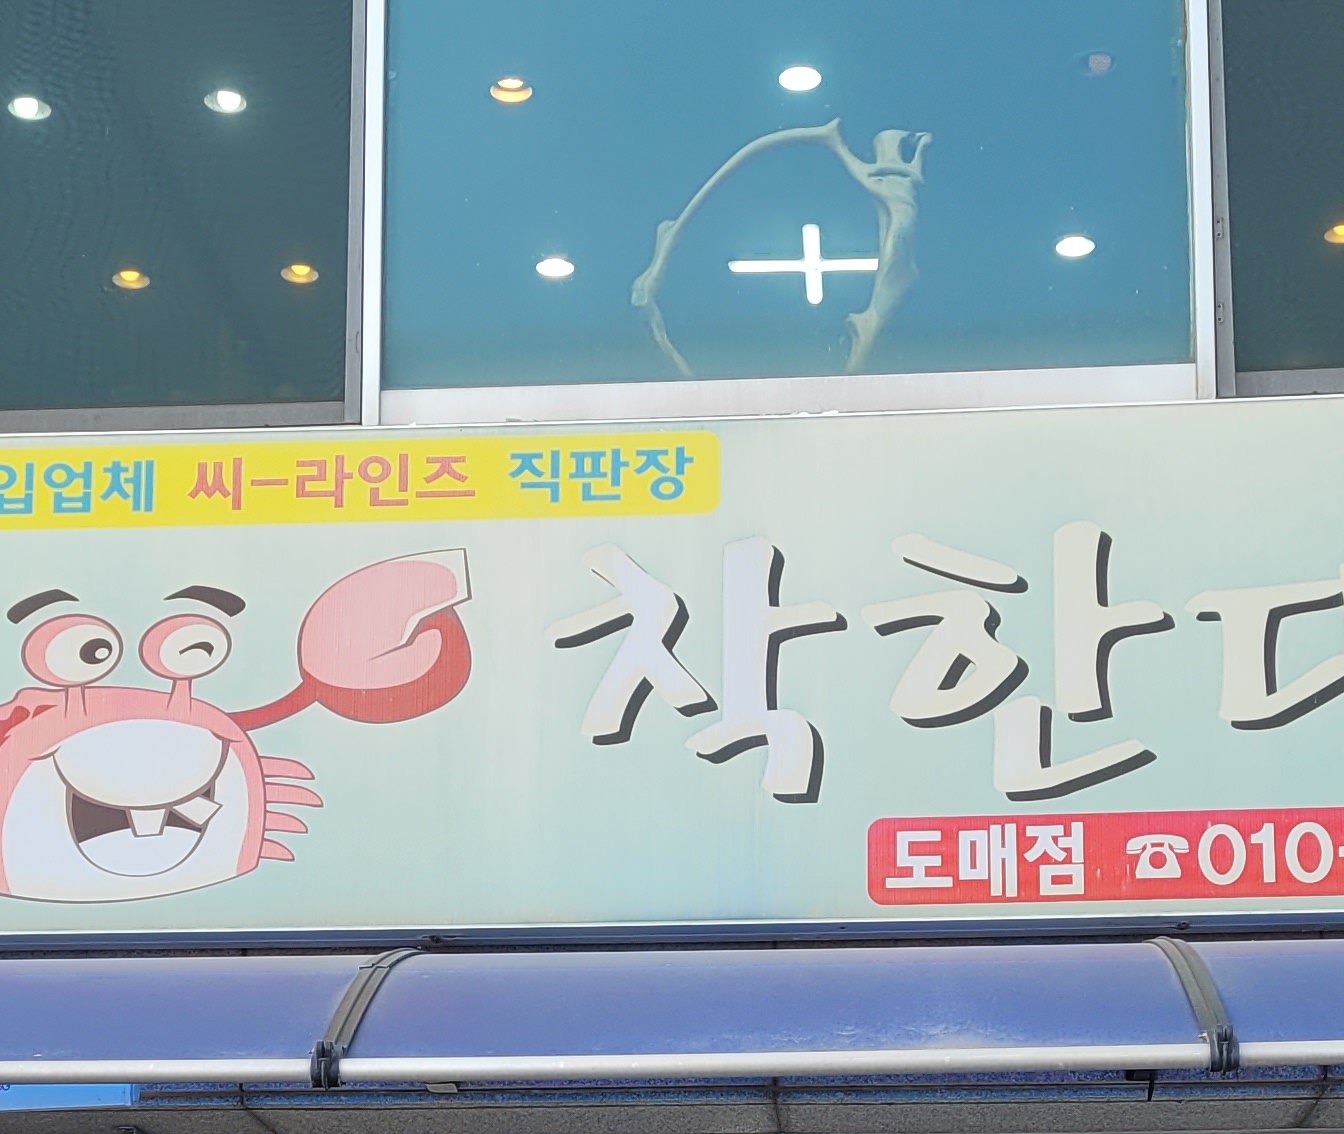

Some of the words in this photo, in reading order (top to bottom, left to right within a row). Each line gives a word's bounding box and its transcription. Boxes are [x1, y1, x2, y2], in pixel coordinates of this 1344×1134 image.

[188, 451, 476, 511] 씨-라인즈
[507, 445, 694, 503] 직판장
[885, 821, 1087, 897] 도매점
